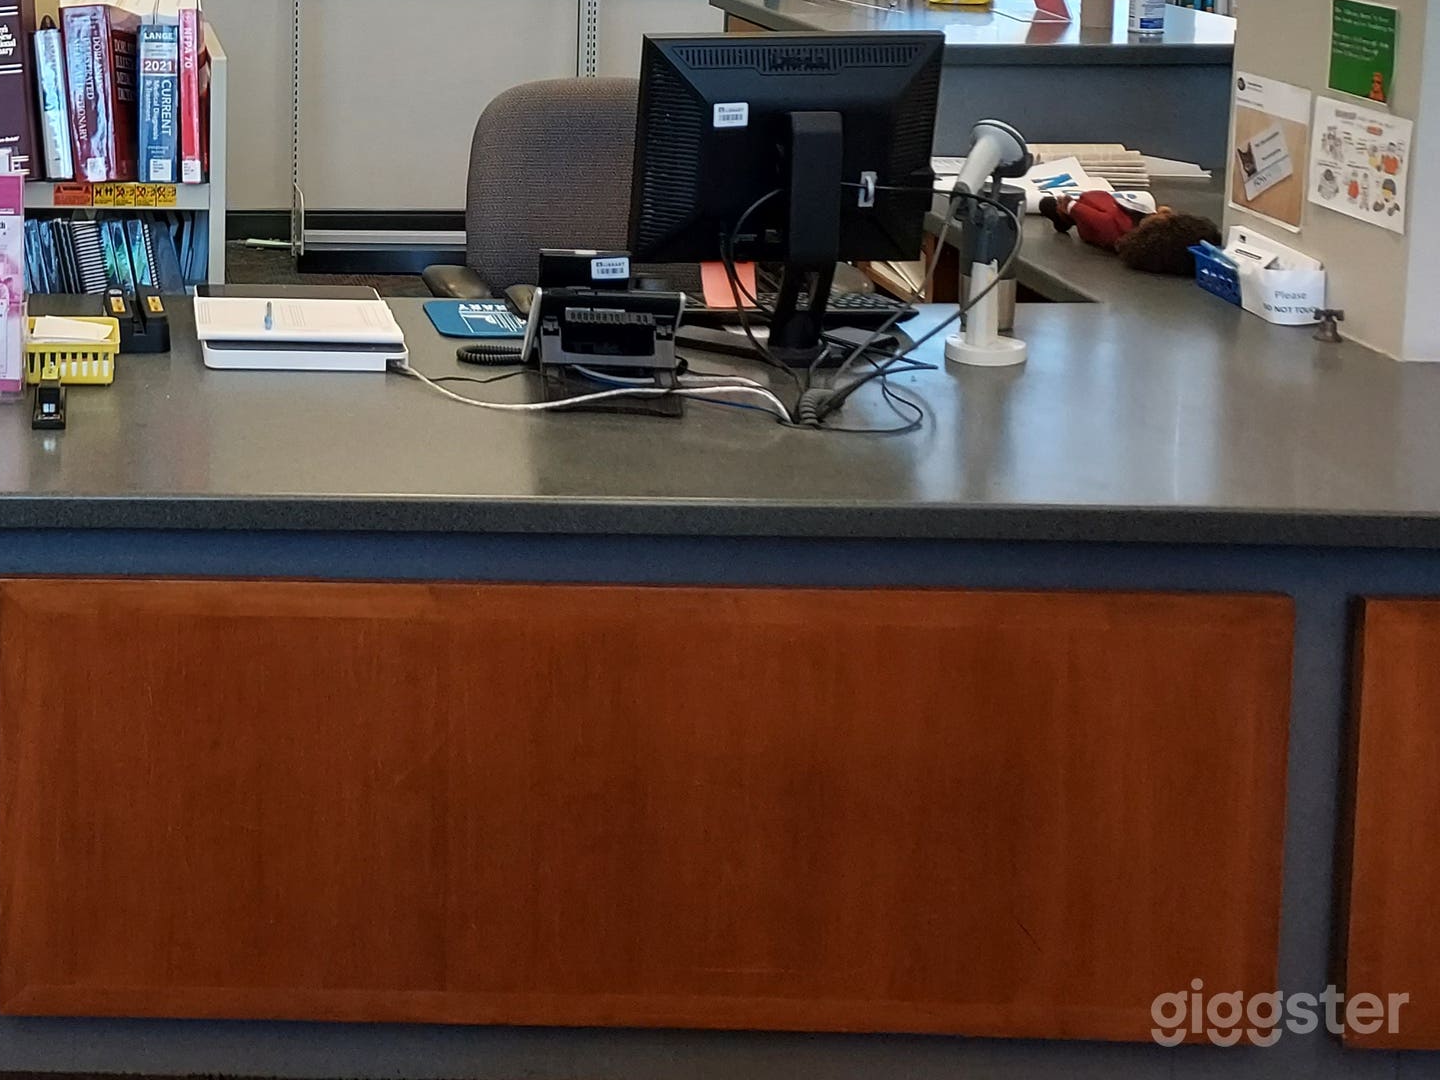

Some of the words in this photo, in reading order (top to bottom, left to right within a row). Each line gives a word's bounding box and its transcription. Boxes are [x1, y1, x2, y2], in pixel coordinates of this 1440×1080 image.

[144, 31, 175, 39] LANGE
[183, 27, 192, 53] NFPA
[144, 60, 173, 71] 2021
[184, 55, 193, 69] 70
[152, 79, 160, 106] Medical
[161, 79, 172, 137] CURRENT
[152, 107, 160, 140] Diagnosis
[1274, 290, 1307, 300] Please
